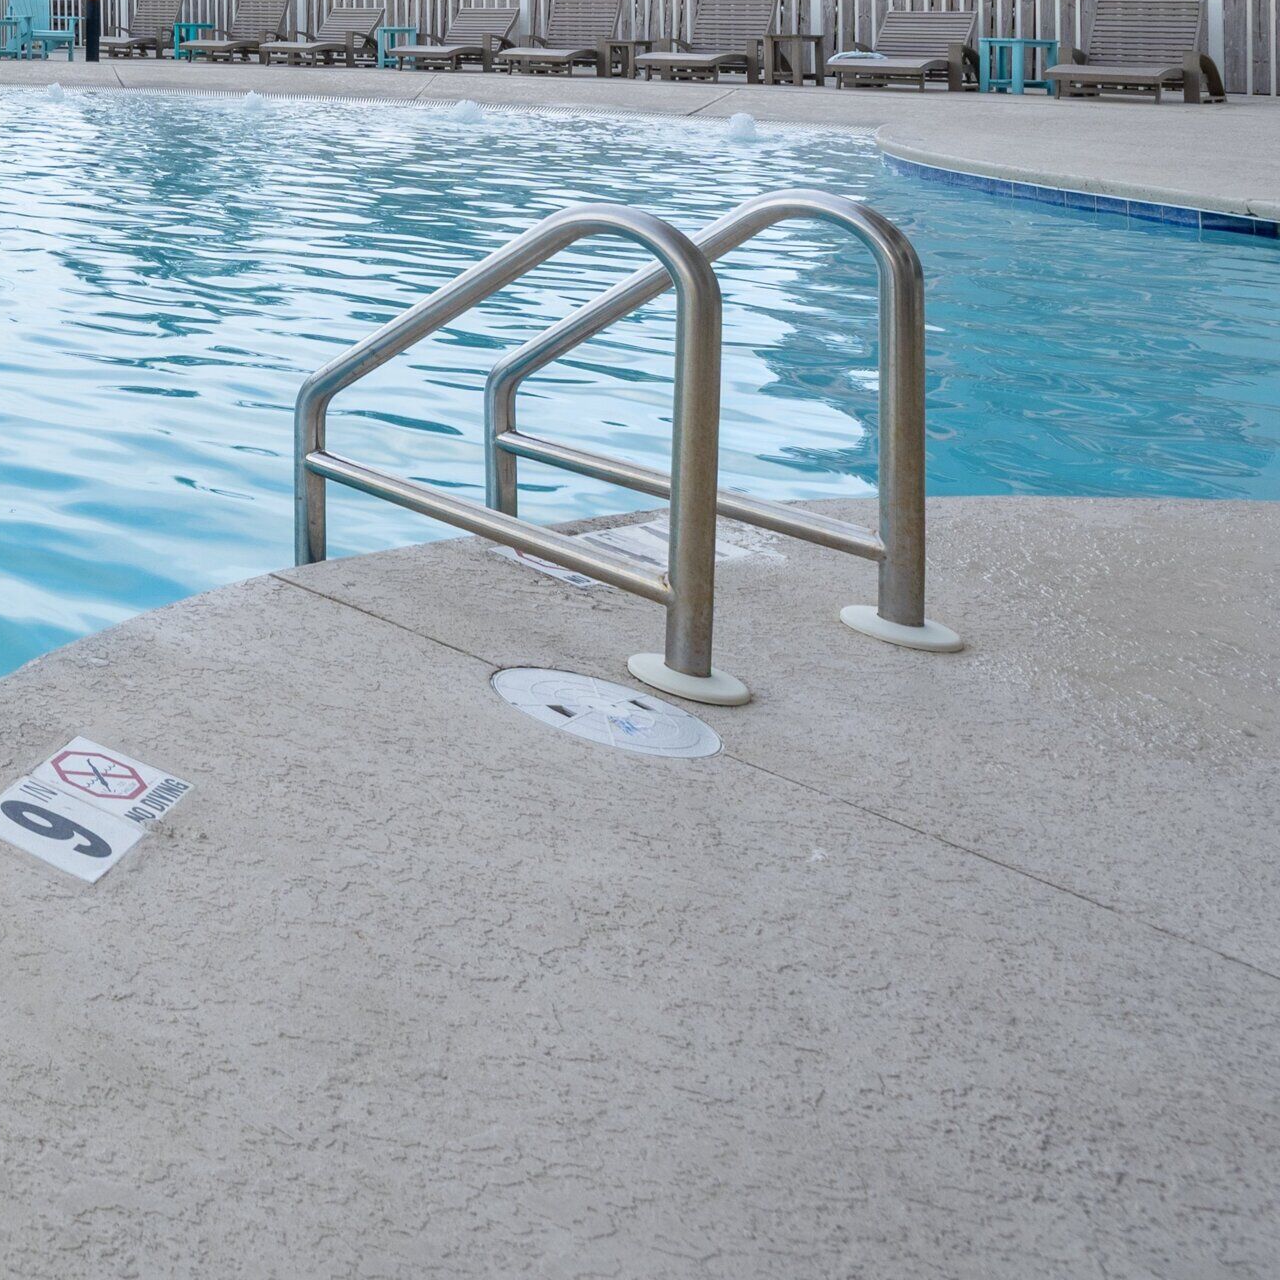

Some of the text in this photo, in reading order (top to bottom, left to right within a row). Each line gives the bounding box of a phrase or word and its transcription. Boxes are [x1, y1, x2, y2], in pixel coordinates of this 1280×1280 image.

[19, 780, 58, 804] IN
[124, 778, 189, 823] NO DIVING
